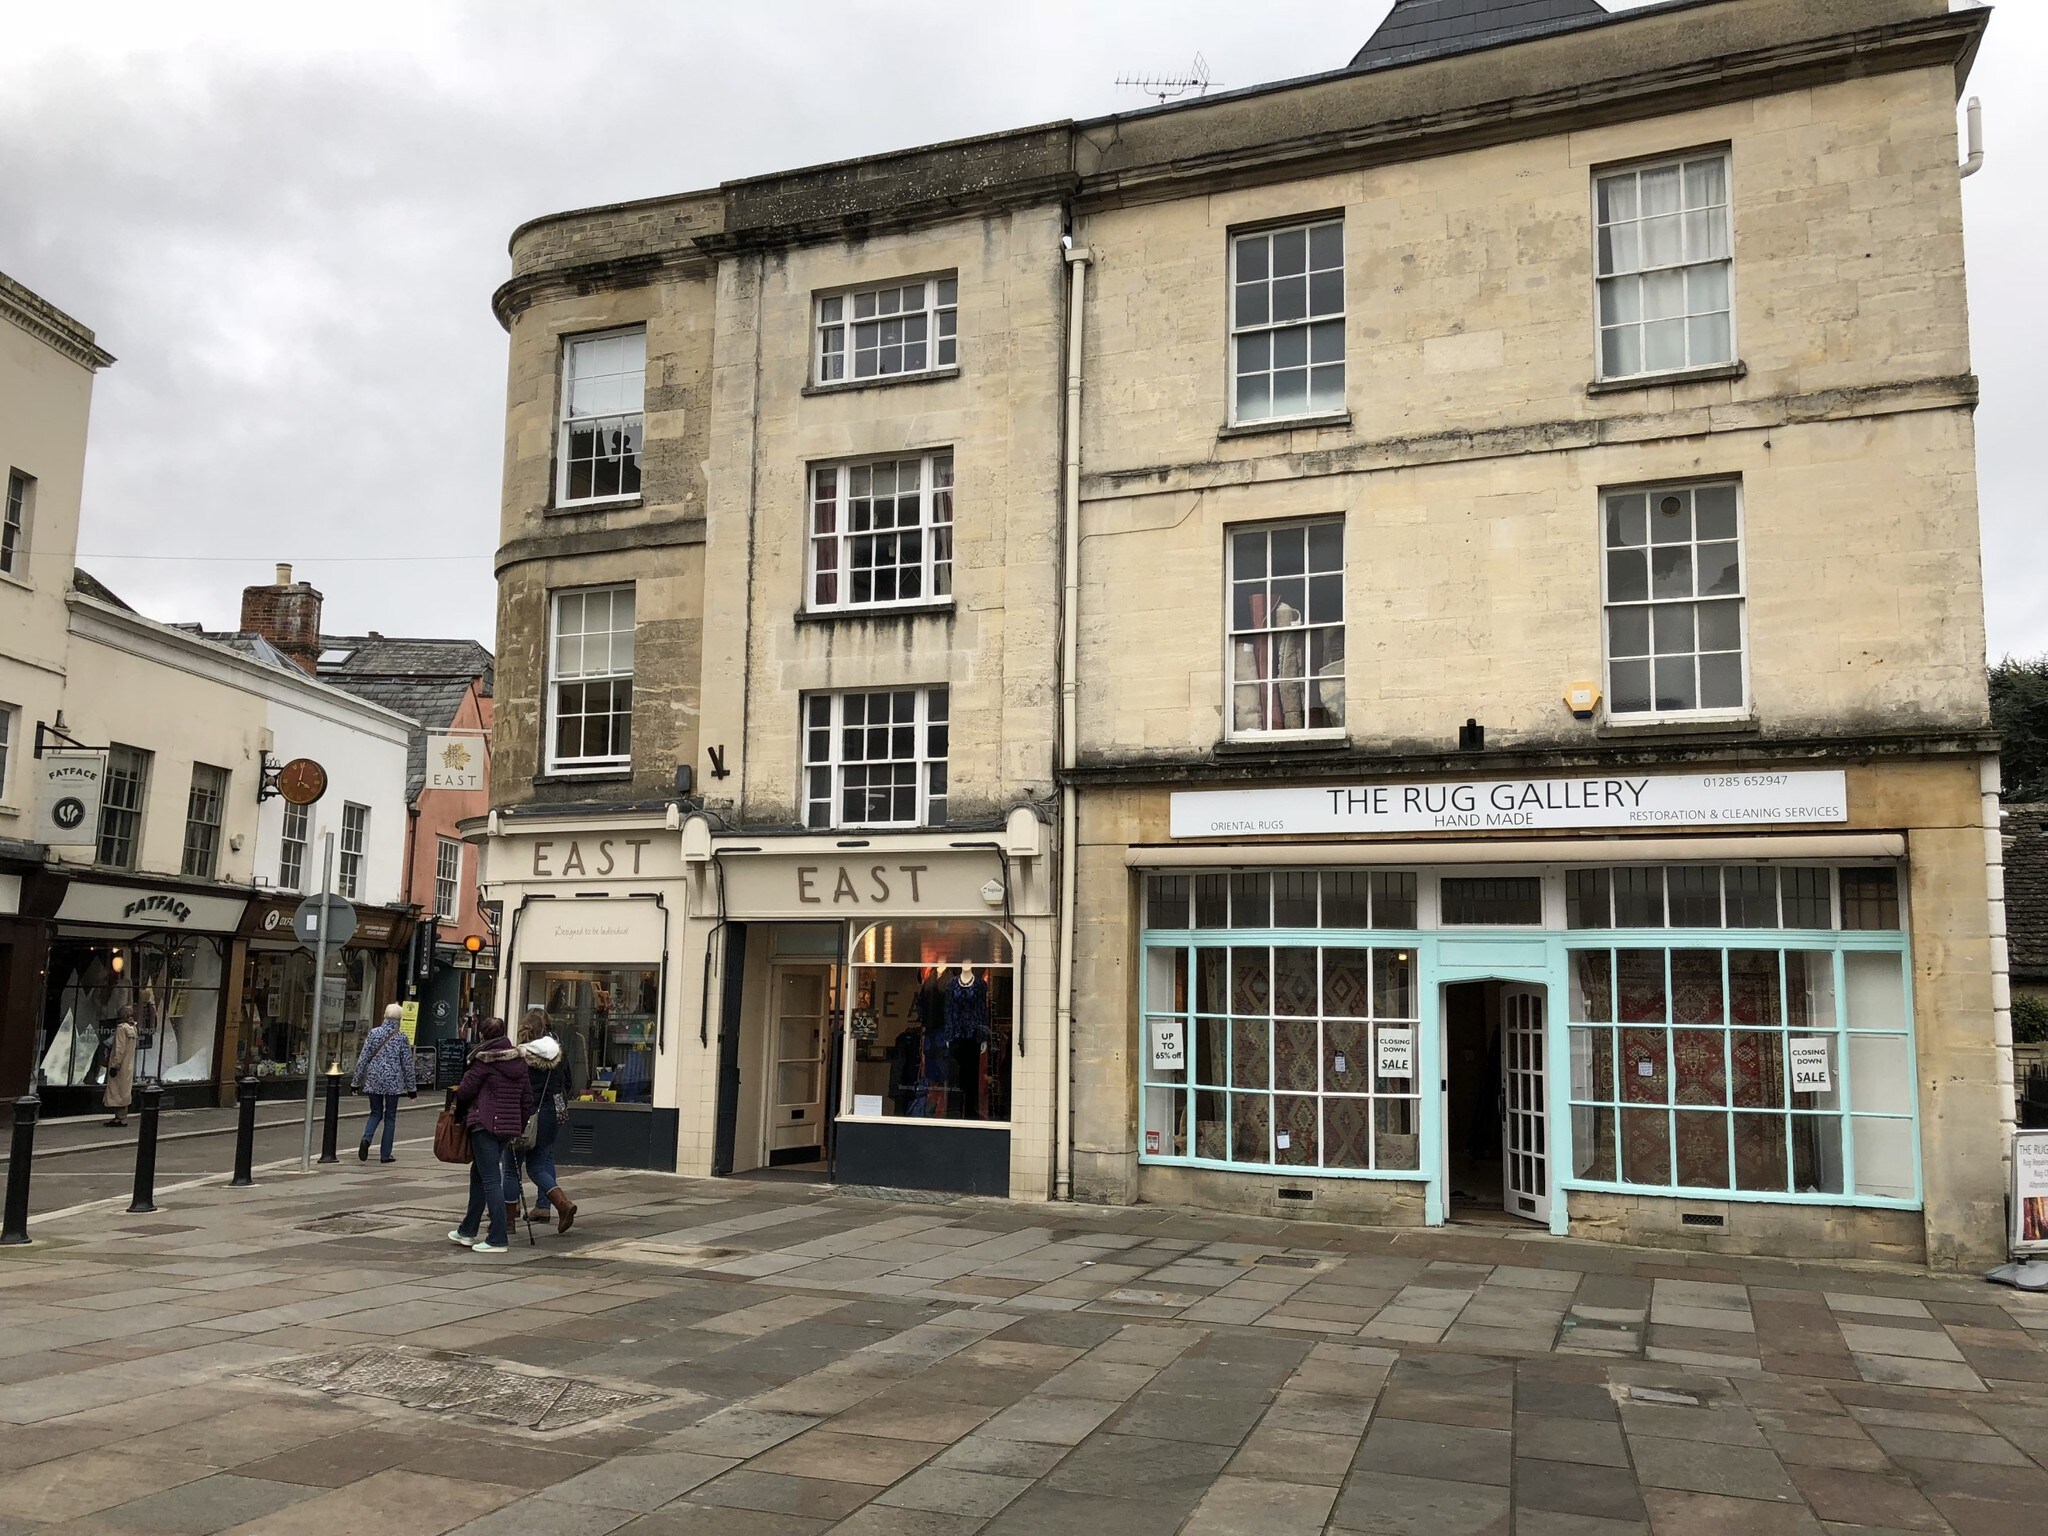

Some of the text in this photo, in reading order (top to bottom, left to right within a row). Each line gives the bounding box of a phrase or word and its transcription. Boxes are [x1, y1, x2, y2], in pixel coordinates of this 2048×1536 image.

[48, 767, 98, 781] FATFACE
[433, 774, 477, 786] EAST
[1703, 775, 1788, 788] 01285 652947
[1326, 779, 1649, 815] THE RUG GALLERY
[1629, 806, 1839, 821] RESTORATION & CLEANING SERVICES
[1210, 820, 1284, 831] ORIENTAL RUGS
[1434, 812, 1534, 828] HAND MADE
[533, 839, 651, 876] EAST
[797, 865, 928, 903] EAST
[123, 895, 191, 922] FATFACE
[279, 916, 295, 926] OXFA
[1161, 1032, 1174, 1040] UP
[1161, 1042, 1175, 1050] TO
[1155, 1051, 1182, 1060] 65% off
[1381, 1058, 1409, 1070] SALE
[1796, 1071, 1826, 1083] SALE
[2019, 1144, 2032, 1155] THE
